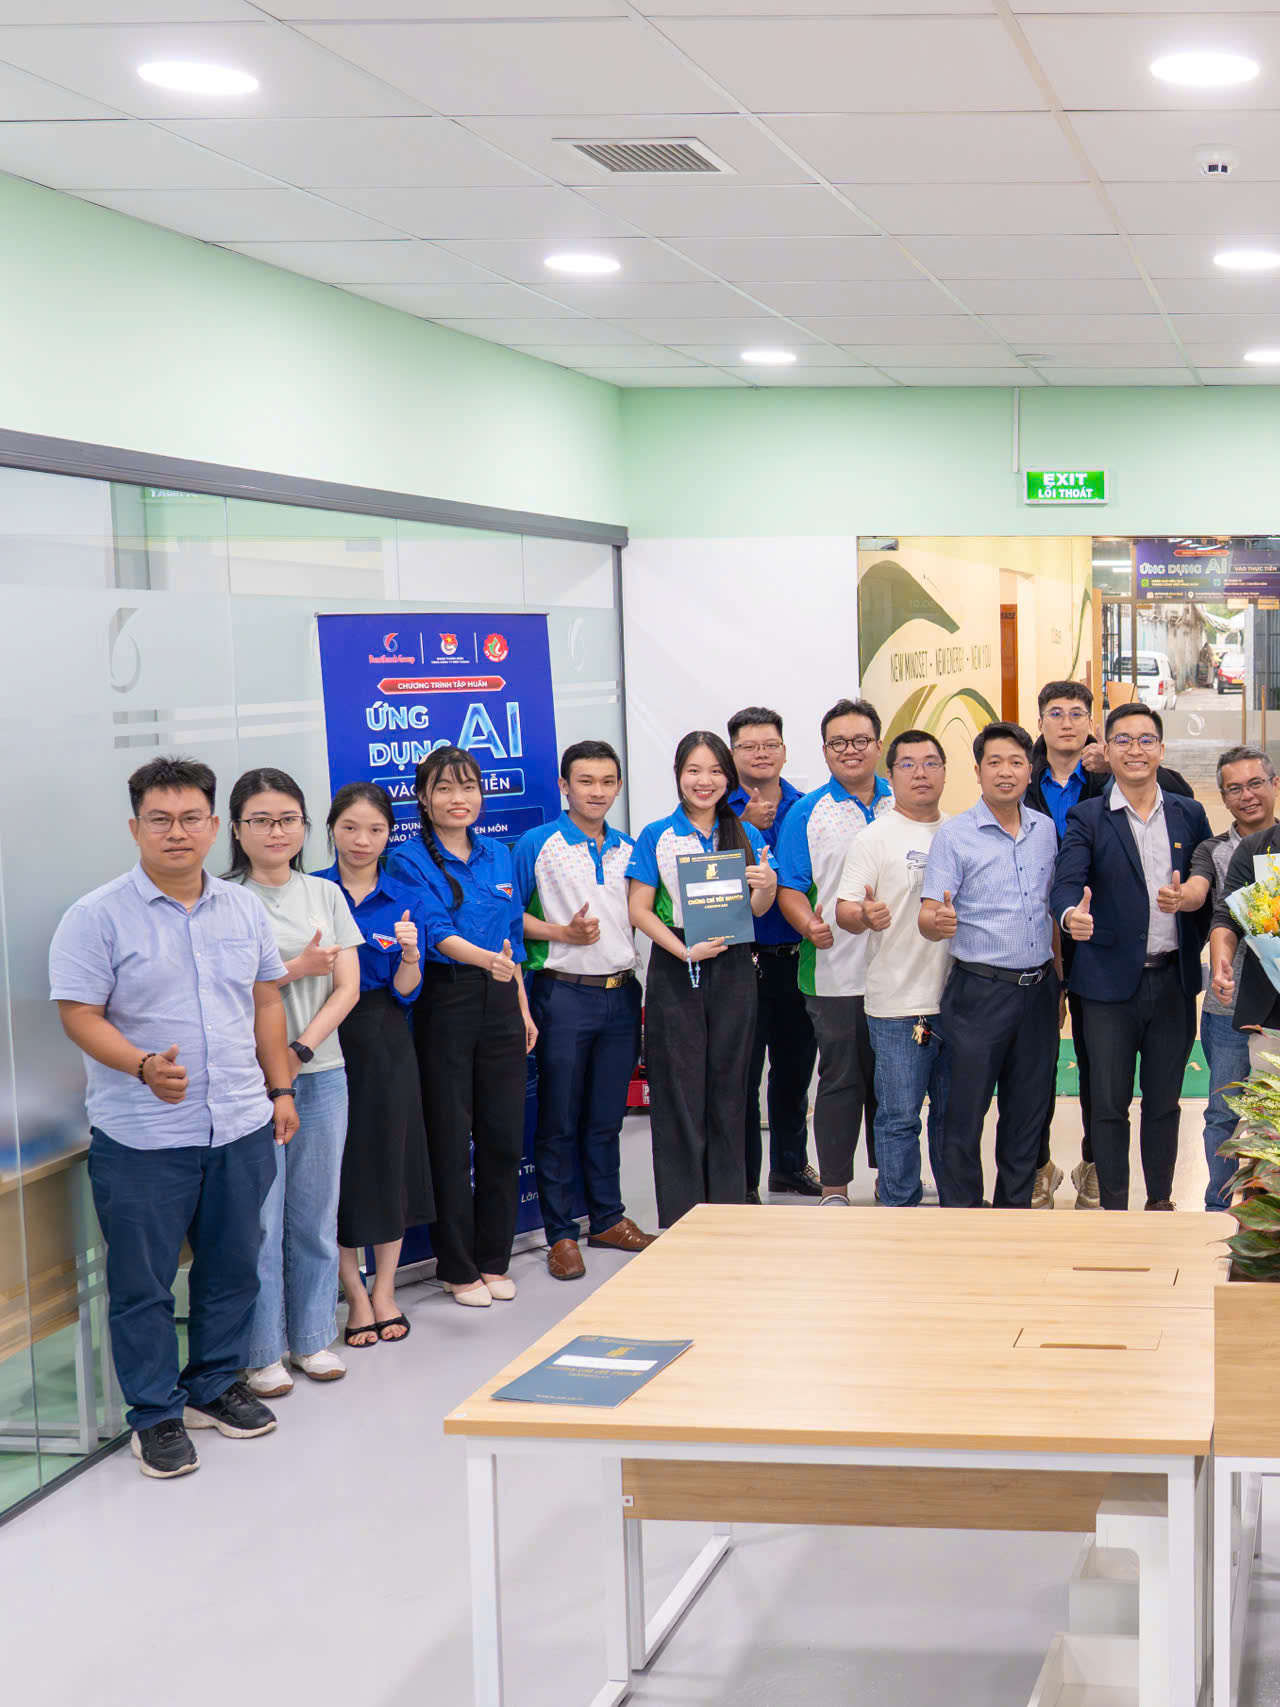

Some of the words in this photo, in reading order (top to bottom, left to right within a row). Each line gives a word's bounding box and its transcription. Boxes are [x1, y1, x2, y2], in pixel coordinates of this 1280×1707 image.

[1043, 473, 1087, 486] EXIT
[1038, 485, 1056, 498] LỐI
[1059, 486, 1094, 498] THOÁT
[1205, 558, 1228, 575] AI
[890, 653, 904, 683] NEW
[904, 650, 928, 681] MINDSET
[398, 682, 429, 690] CHƯƠNG
[430, 681, 452, 689] TRÌNH
[453, 680, 466, 689] TẬP
[467, 679, 488, 688] HUẤN
[366, 701, 429, 731] ỨNG
[457, 701, 523, 759] AI
[481, 773, 510, 791] IỄN
[401, 822, 423, 833] DỤN
[488, 824, 508, 833] MÔN
